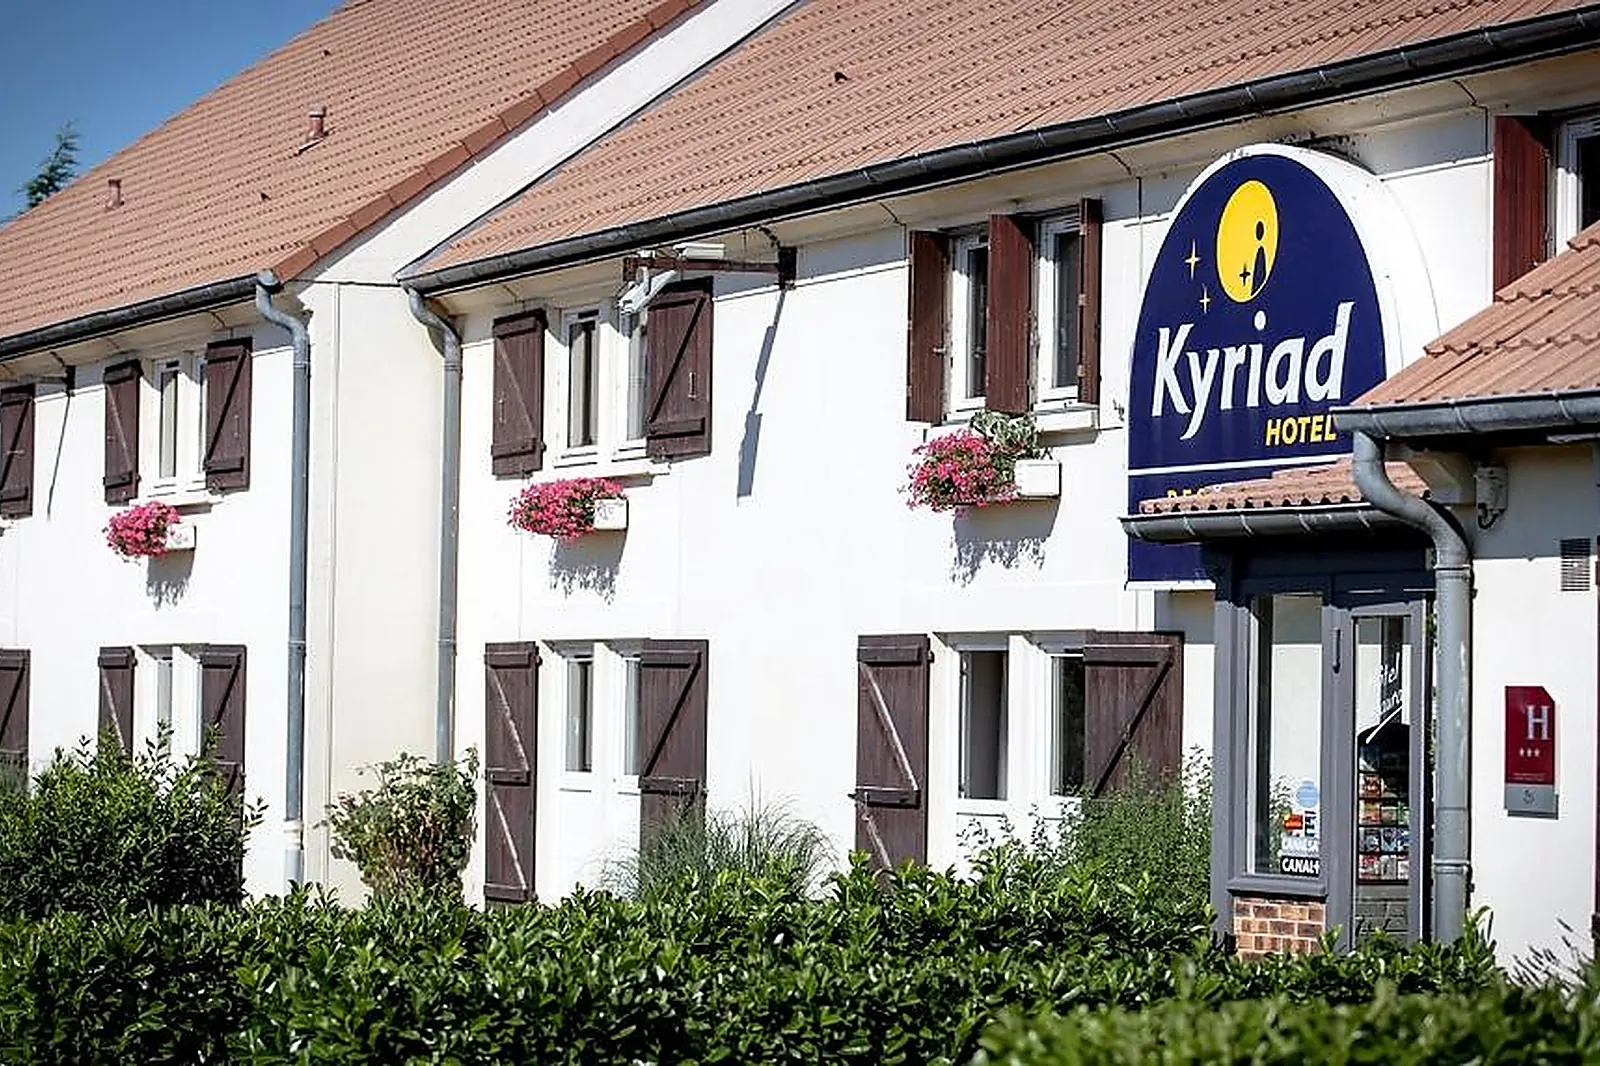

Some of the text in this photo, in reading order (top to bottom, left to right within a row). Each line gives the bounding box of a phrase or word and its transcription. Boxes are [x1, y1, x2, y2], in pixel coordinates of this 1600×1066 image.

[1152, 301, 1355, 440] Kyriad
[1265, 414, 1337, 446] HOTEL
[1525, 705, 1551, 740] H
[1282, 858, 1320, 874] CANAL+
